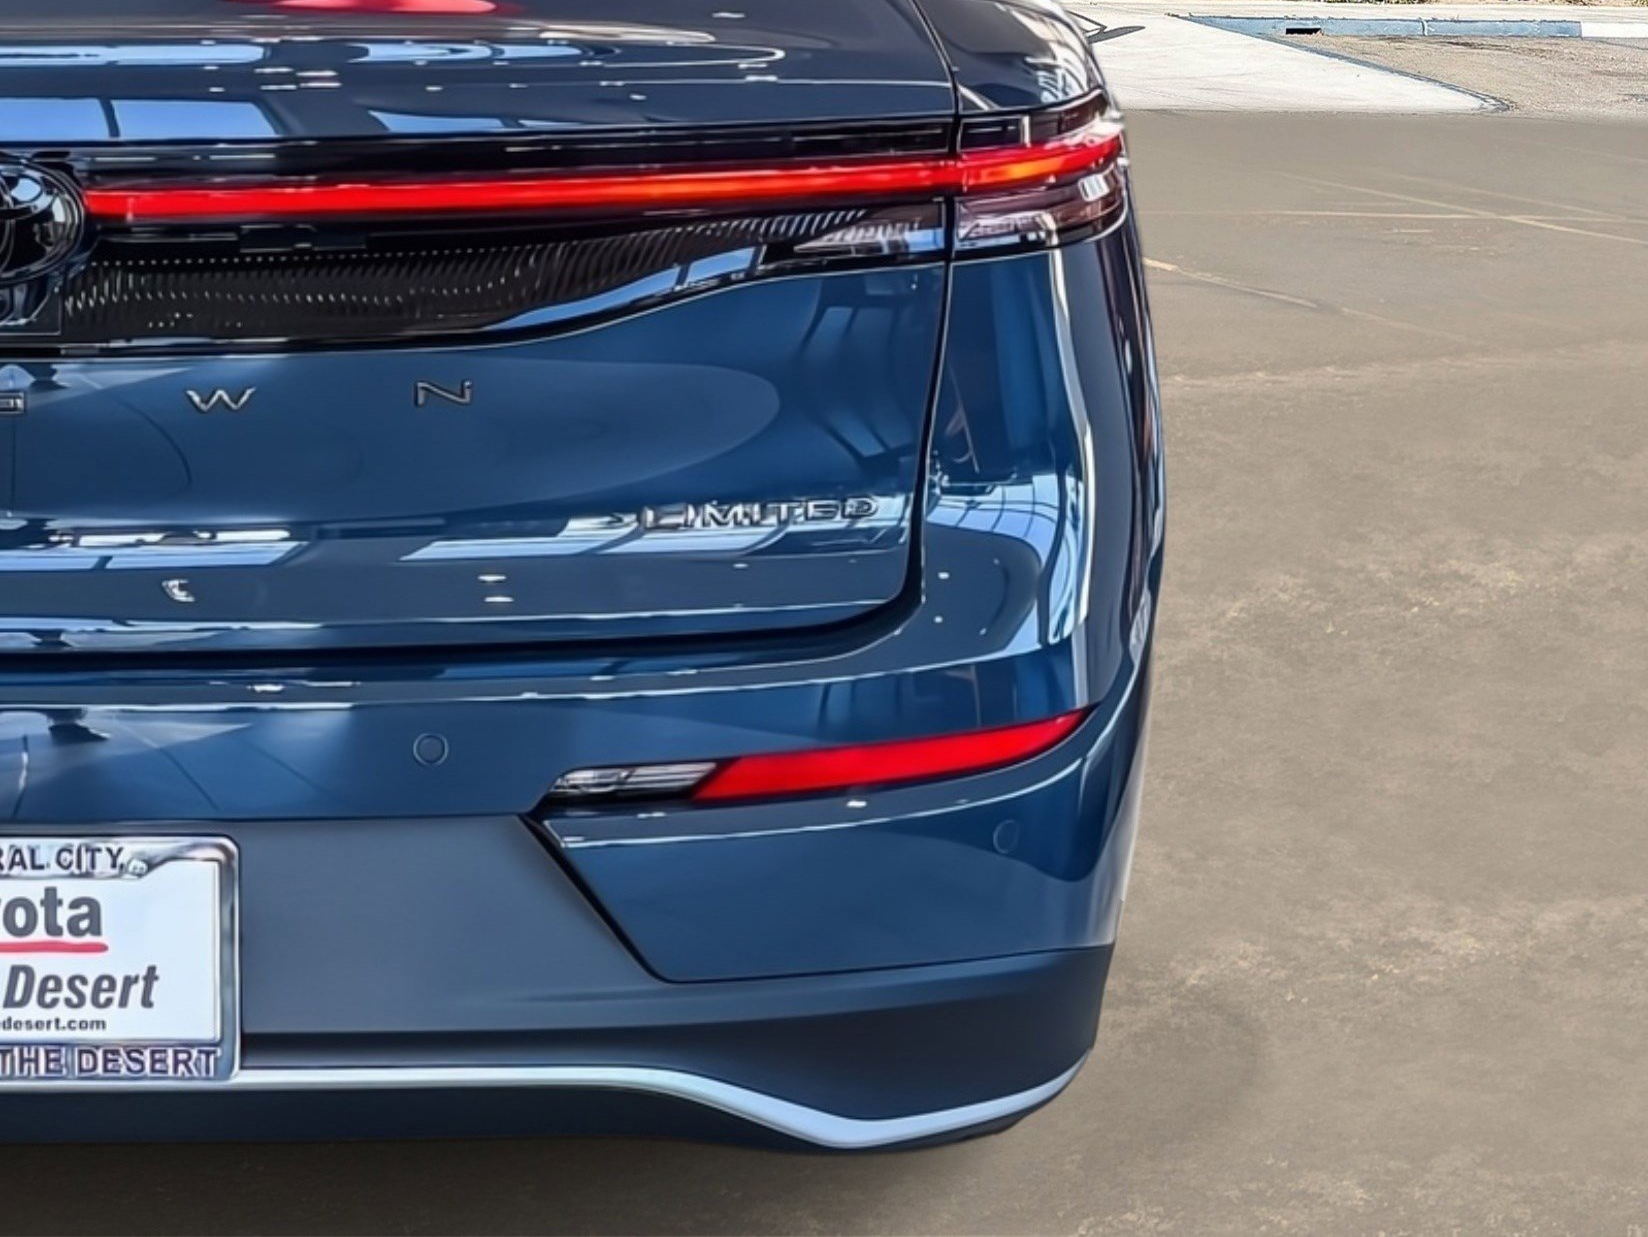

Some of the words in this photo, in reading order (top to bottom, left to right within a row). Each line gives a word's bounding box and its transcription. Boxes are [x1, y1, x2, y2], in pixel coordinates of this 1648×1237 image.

[641, 496, 879, 530] LIMITED
[55, 845, 125, 871] CITY
[3, 964, 160, 1009] Desert
[77, 1047, 221, 1076] DESERT
